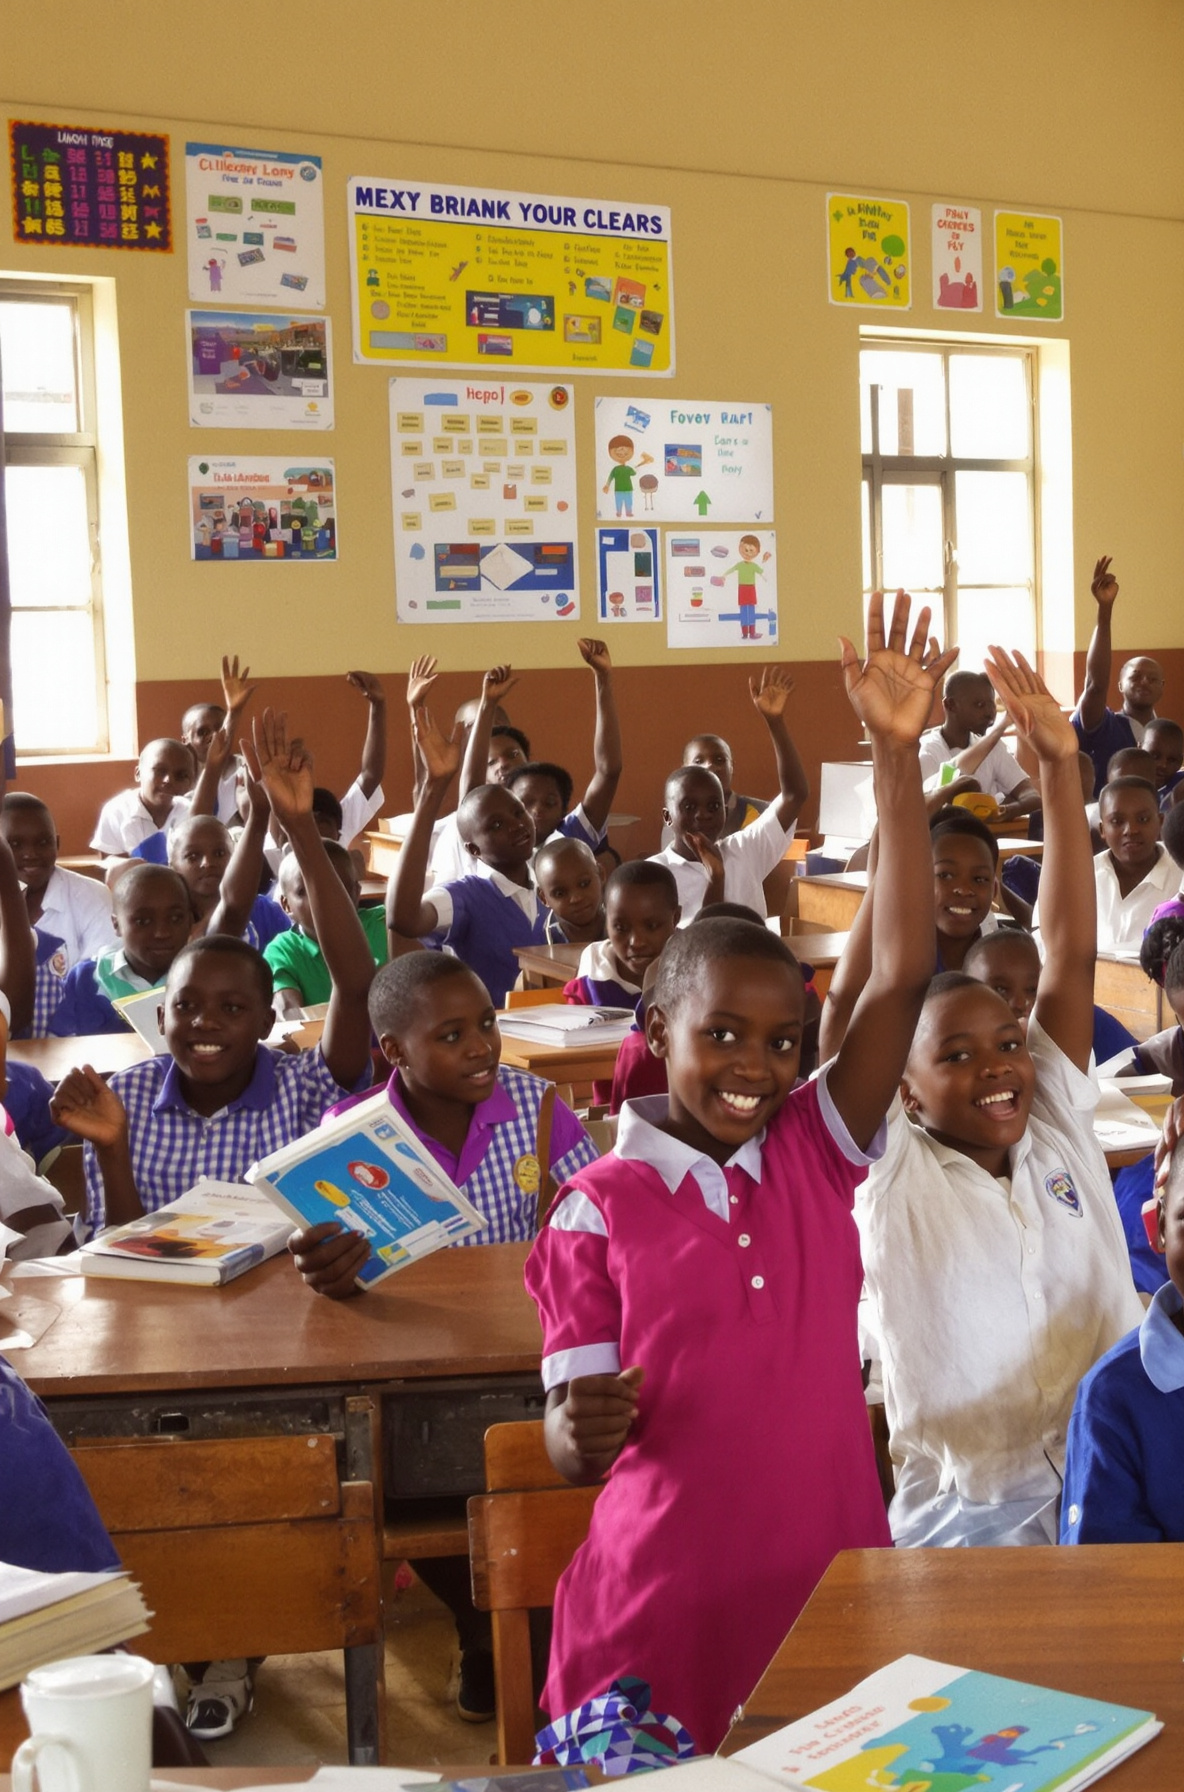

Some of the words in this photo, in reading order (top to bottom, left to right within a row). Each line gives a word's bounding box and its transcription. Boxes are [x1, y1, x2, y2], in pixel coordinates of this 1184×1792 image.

[356, 186, 421, 212] MEXY
[430, 194, 511, 220] BRIANK
[518, 202, 577, 227] YOUR
[583, 208, 663, 234] CLEARS
